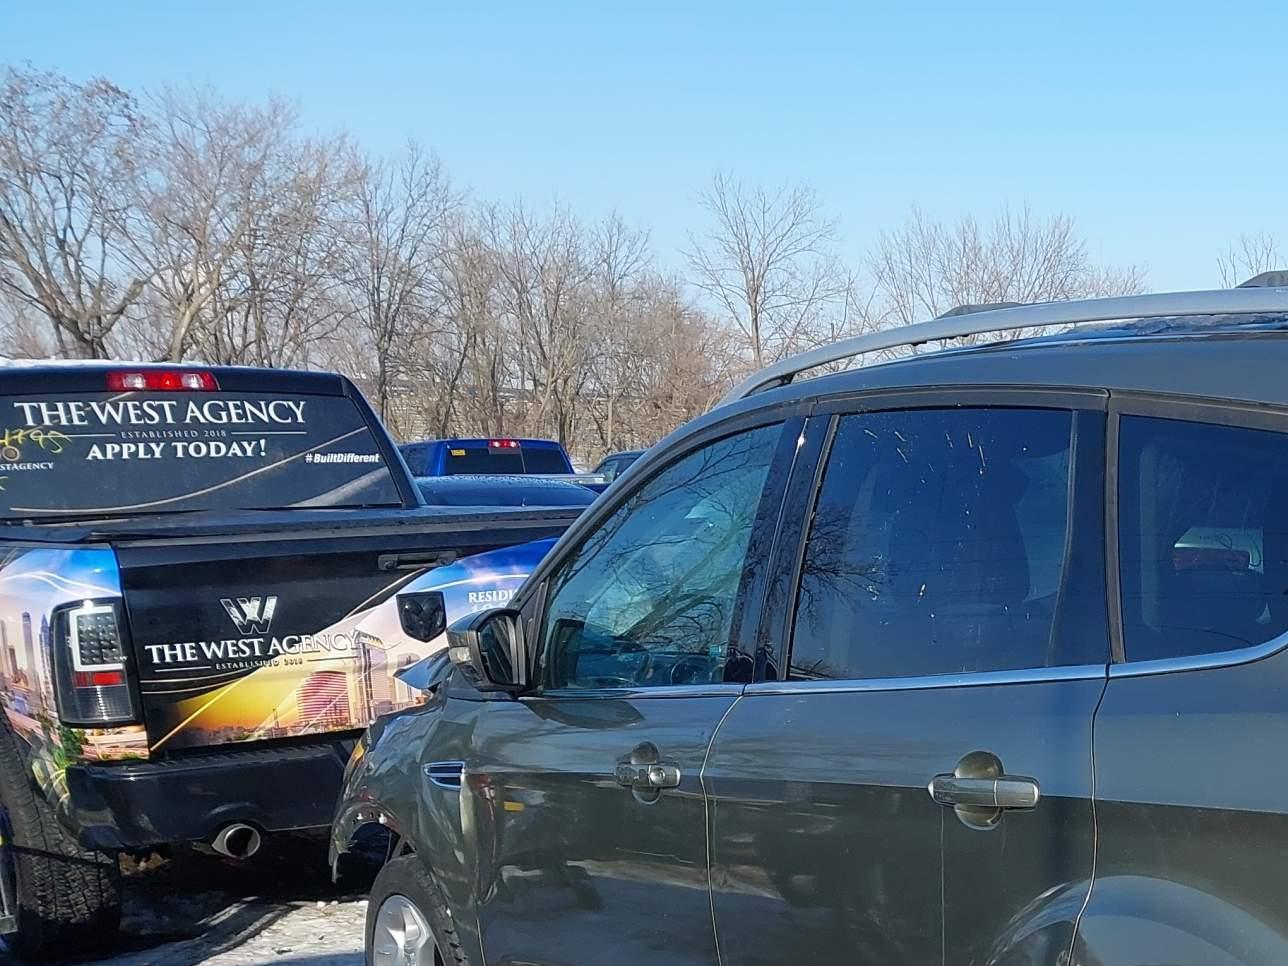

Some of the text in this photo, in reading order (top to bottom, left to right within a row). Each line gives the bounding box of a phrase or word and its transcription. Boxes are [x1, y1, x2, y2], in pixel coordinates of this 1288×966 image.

[14, 400, 307, 426] THE WEST AGENCY
[121, 429, 227, 439] ESTABLISHED 2018
[85, 438, 267, 460] APPLY TODAY!
[305, 452, 380, 464] #BuiltDifferent
[145, 631, 360, 664] THE WEST AGENCY
